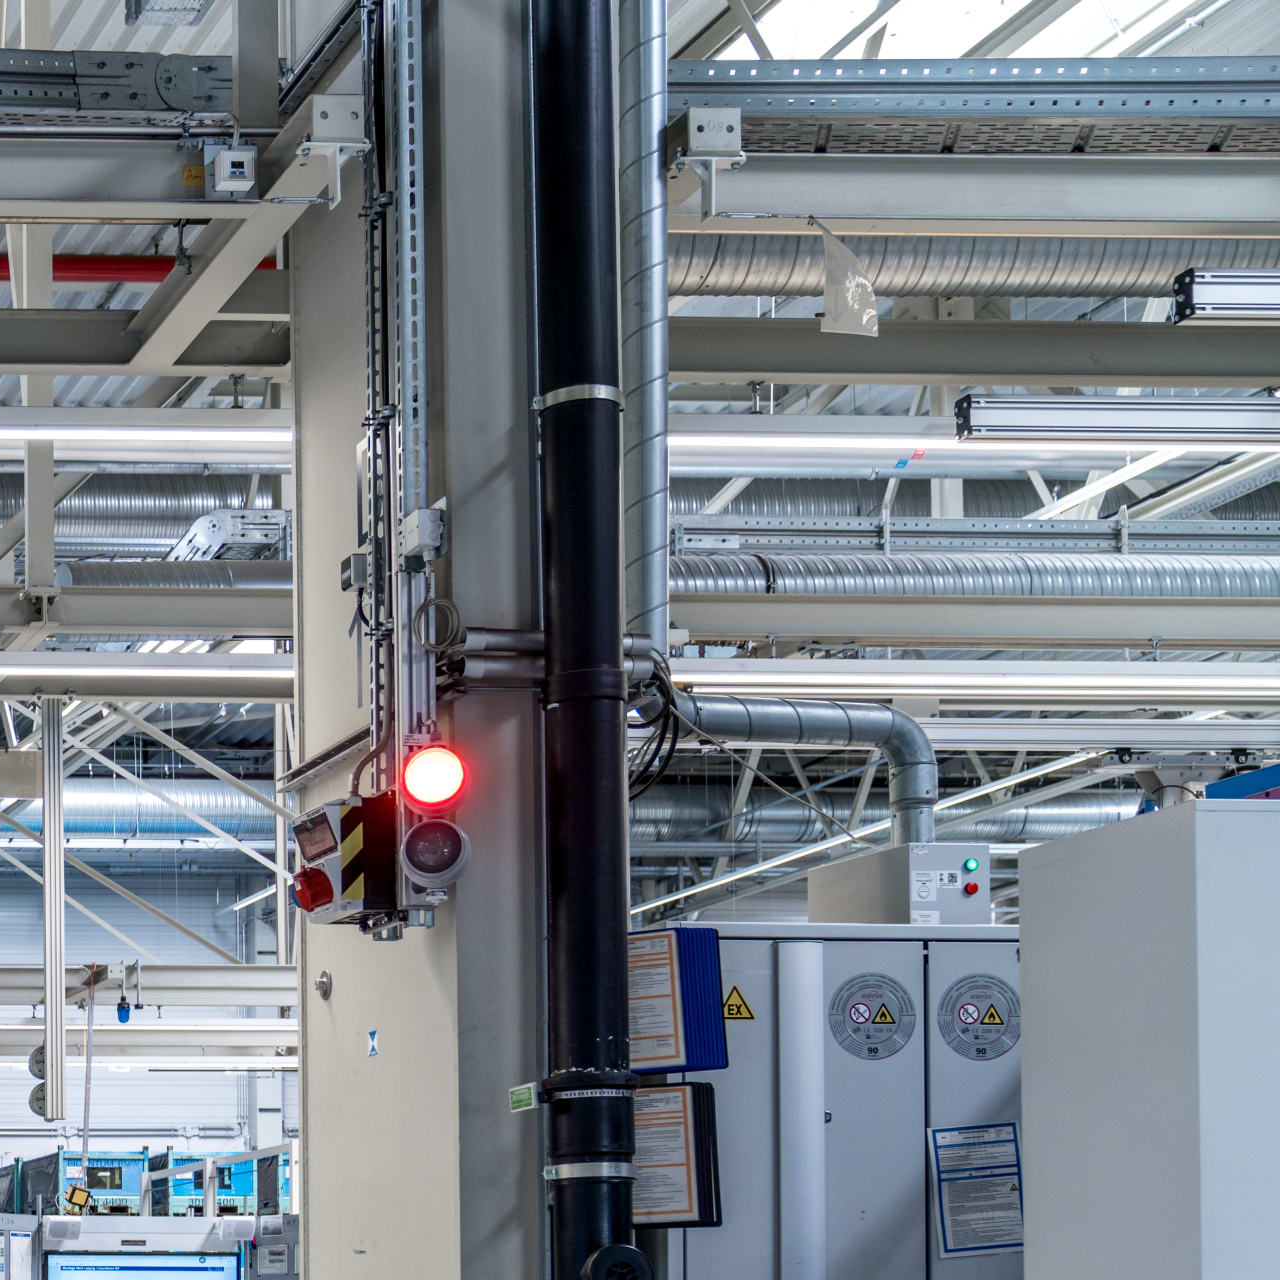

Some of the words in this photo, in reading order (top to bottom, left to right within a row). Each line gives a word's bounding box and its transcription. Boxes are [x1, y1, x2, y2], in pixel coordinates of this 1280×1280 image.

[727, 1003, 743, 1016] EX
[867, 1046, 879, 1055] 90
[976, 1047, 987, 1056] 90
[67, 1159, 114, 1168] EIGNTUM
